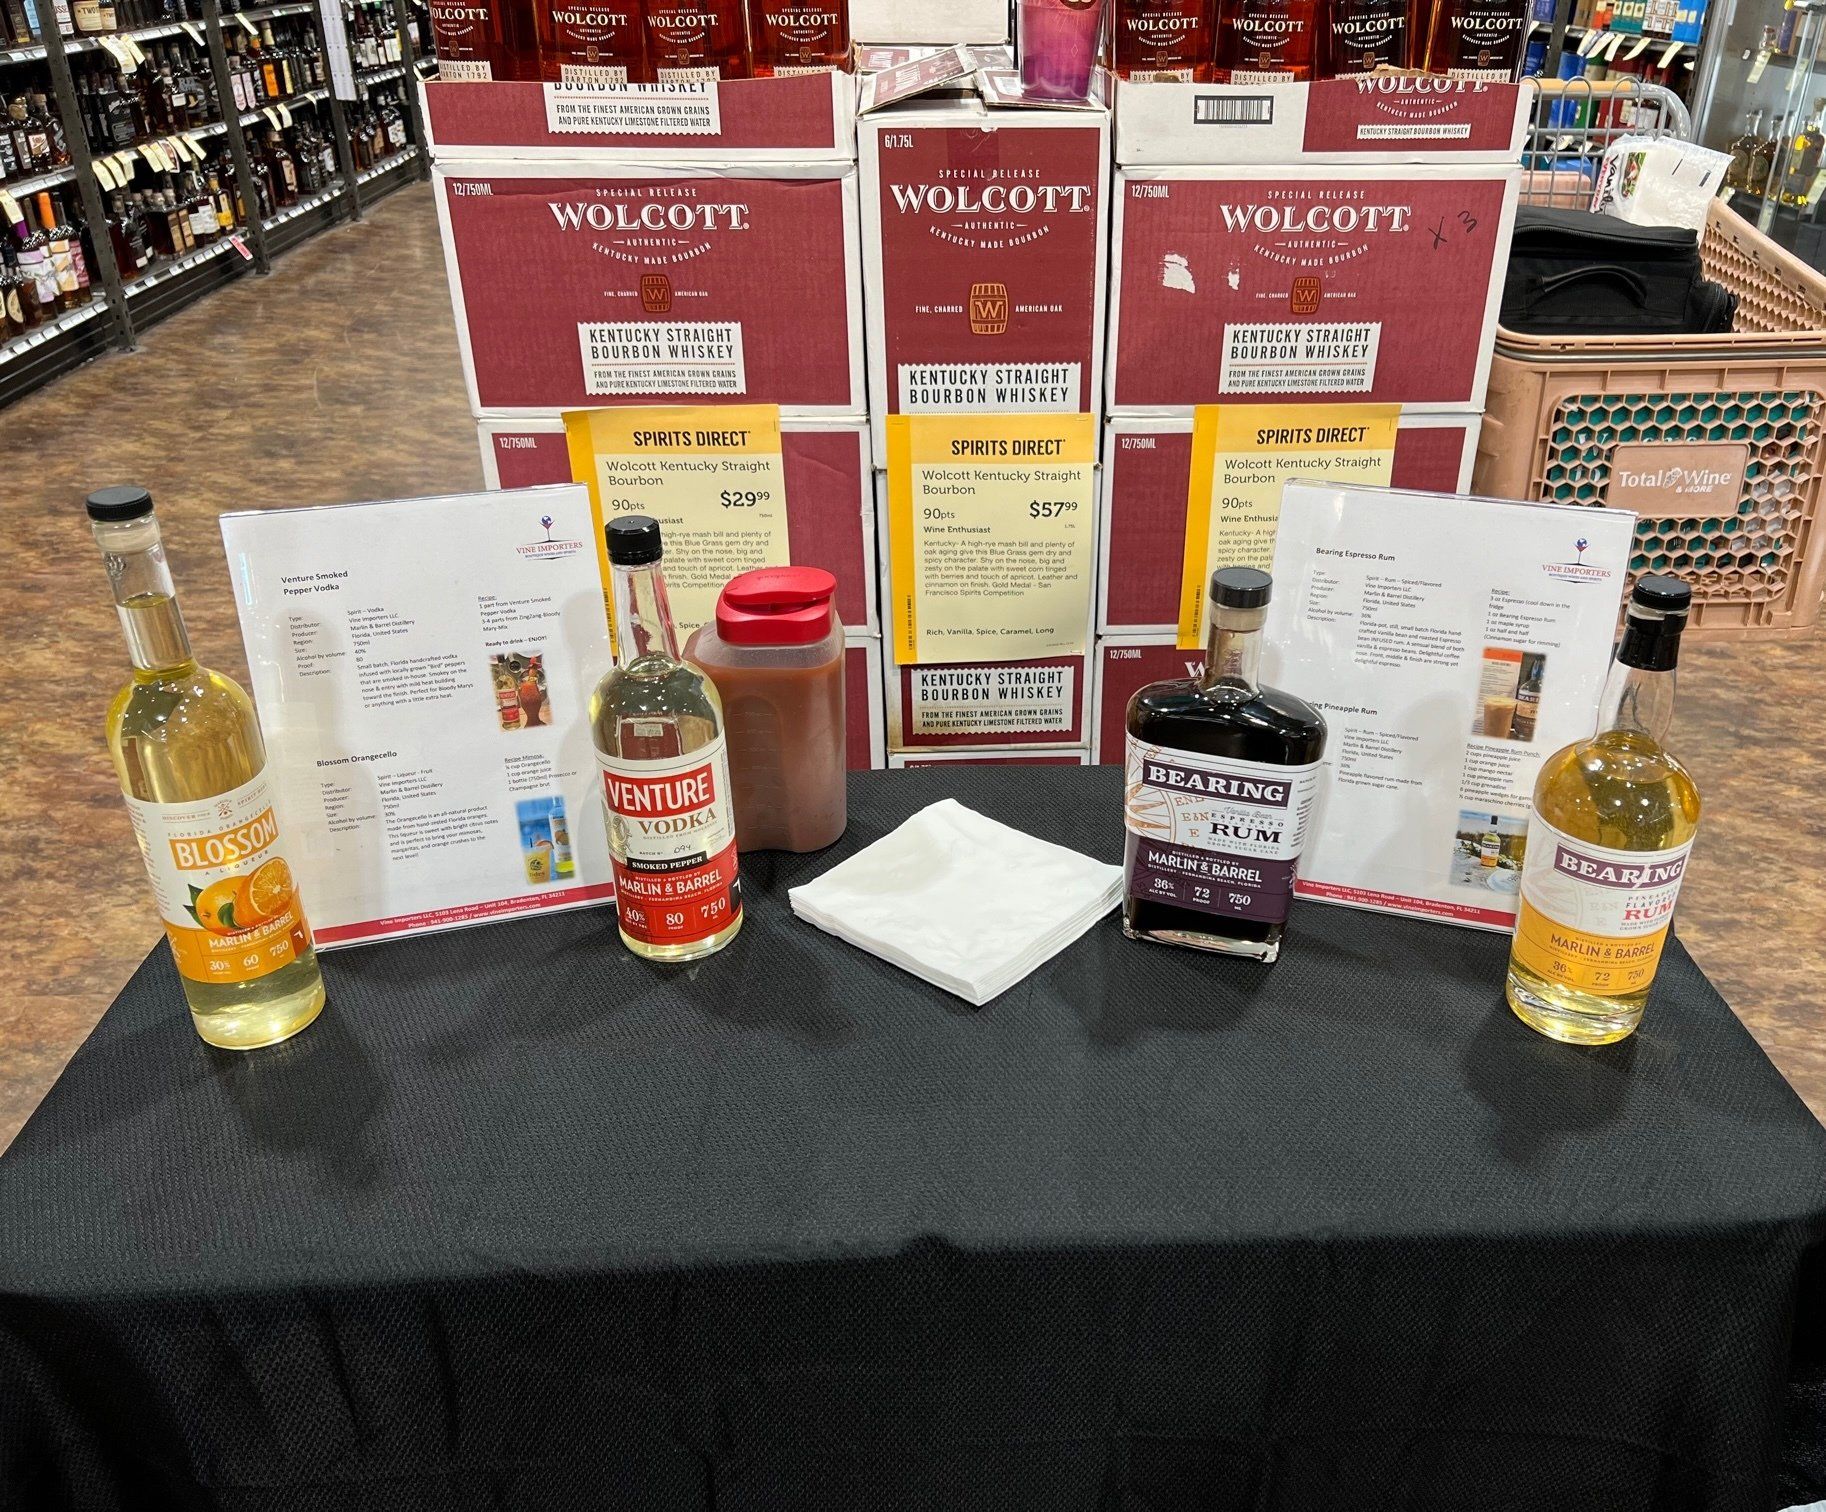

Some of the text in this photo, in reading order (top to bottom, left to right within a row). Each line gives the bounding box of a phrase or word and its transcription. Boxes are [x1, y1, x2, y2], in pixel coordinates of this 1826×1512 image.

[614, 69, 624, 77] BY
[556, 105, 709, 115] FROM THE FINEST AMERICAN GROWN GRAINS
[1360, 126, 1387, 135] KENTUCKY
[1442, 127, 1468, 135] WHISKEY
[885, 135, 913, 149] 6/1.75L
[939, 170, 1040, 178] SPECIAL RELEASE
[453, 183, 493, 196] 12/750ML
[650, 189, 697, 197] RELEASE
[1131, 185, 1169, 199] 12/750ML
[1268, 190, 1365, 199] SPECIAL RELEASE
[964, 221, 1015, 229] AUTHENTIC
[627, 238, 676, 246] AUTHENTIC
[929, 225, 1050, 248] KENTUCKY MADE BOURBON
[1287, 240, 1336, 249] AUTHENTIC
[915, 306, 932, 314] FINE,
[934, 305, 963, 313] CHARRED
[590, 329, 732, 343] KENTUCKY STRAIGHT
[1233, 329, 1371, 343] KENTUCKY STRAIGHT
[592, 345, 733, 359] BOURBON WHISKEY
[1231, 345, 1369, 359] BOURBON WHISKEY
[909, 368, 1069, 386] KENTUCKY STRAIGHT
[910, 387, 1069, 404] BOURBON WHISKEY
[634, 431, 747, 447] SPIRITS DIRECT
[1257, 427, 1366, 444] SPIRITS DIRECT
[499, 436, 537, 450] 12/750ML
[952, 439, 1062, 455] SPIRITS DIRECT
[606, 461, 770, 473] Wolcott Kentucky Straight
[1225, 457, 1381, 469] Wolcott Kentucky Straight
[608, 476, 664, 486] Bourbon
[922, 470, 1081, 483] Wolcott Kentucky Straight
[1224, 474, 1275, 484] Bourbon
[1619, 469, 1730, 487] Total Wine
[923, 485, 975, 495] Bourbon
[612, 500, 645, 511] 90pts
[1222, 497, 1253, 509] 90pts
[924, 508, 955, 520] 90pts
[516, 546, 536, 554] VINE
[538, 542, 583, 552] IMPORTERS
[1316, 548, 1343, 557] Bearing
[1345, 550, 1377, 561] Espresso
[282, 571, 348, 583] Venture Smoked
[1542, 564, 1562, 573] VINE
[1564, 567, 1611, 577] IMPORTERS
[284, 584, 340, 595] Pepper Vodka
[922, 671, 1063, 686] KENTUCKY STRAIGHT
[922, 686, 1063, 701] BOURBON WHISKEY
[1324, 702, 1377, 715] Pineapple Rum
[316, 750, 397, 767] Blossom Orangecello
[1148, 765, 1284, 802] BEARING
[608, 772, 710, 812] VENTURE
[637, 807, 717, 835] VODKA
[1211, 813, 1284, 828] ESPRESSO
[175, 811, 277, 868] BLOSSOM
[1210, 822, 1282, 844] RUM
[632, 856, 703, 870] SMOKED PEPPER
[1149, 850, 1262, 883] MARLIN & BARREL
[1559, 852, 1682, 884] BEARING
[619, 869, 722, 895] MARLIN & BARREL
[1195, 886, 1210, 898] 72
[1228, 893, 1251, 906] 750
[666, 912, 684, 925] 80
[701, 898, 726, 919] 750
[1624, 901, 1673, 921] RUM
[208, 932, 251, 949] MARLIN
[262, 914, 293, 936] BARREL
[243, 954, 259, 967] 60
[269, 940, 289, 956] 750
[1550, 934, 1600, 958] MARLIN
[1615, 943, 1655, 959] BARREL
[1595, 971, 1610, 981] 72
[1628, 968, 1645, 981] 750
